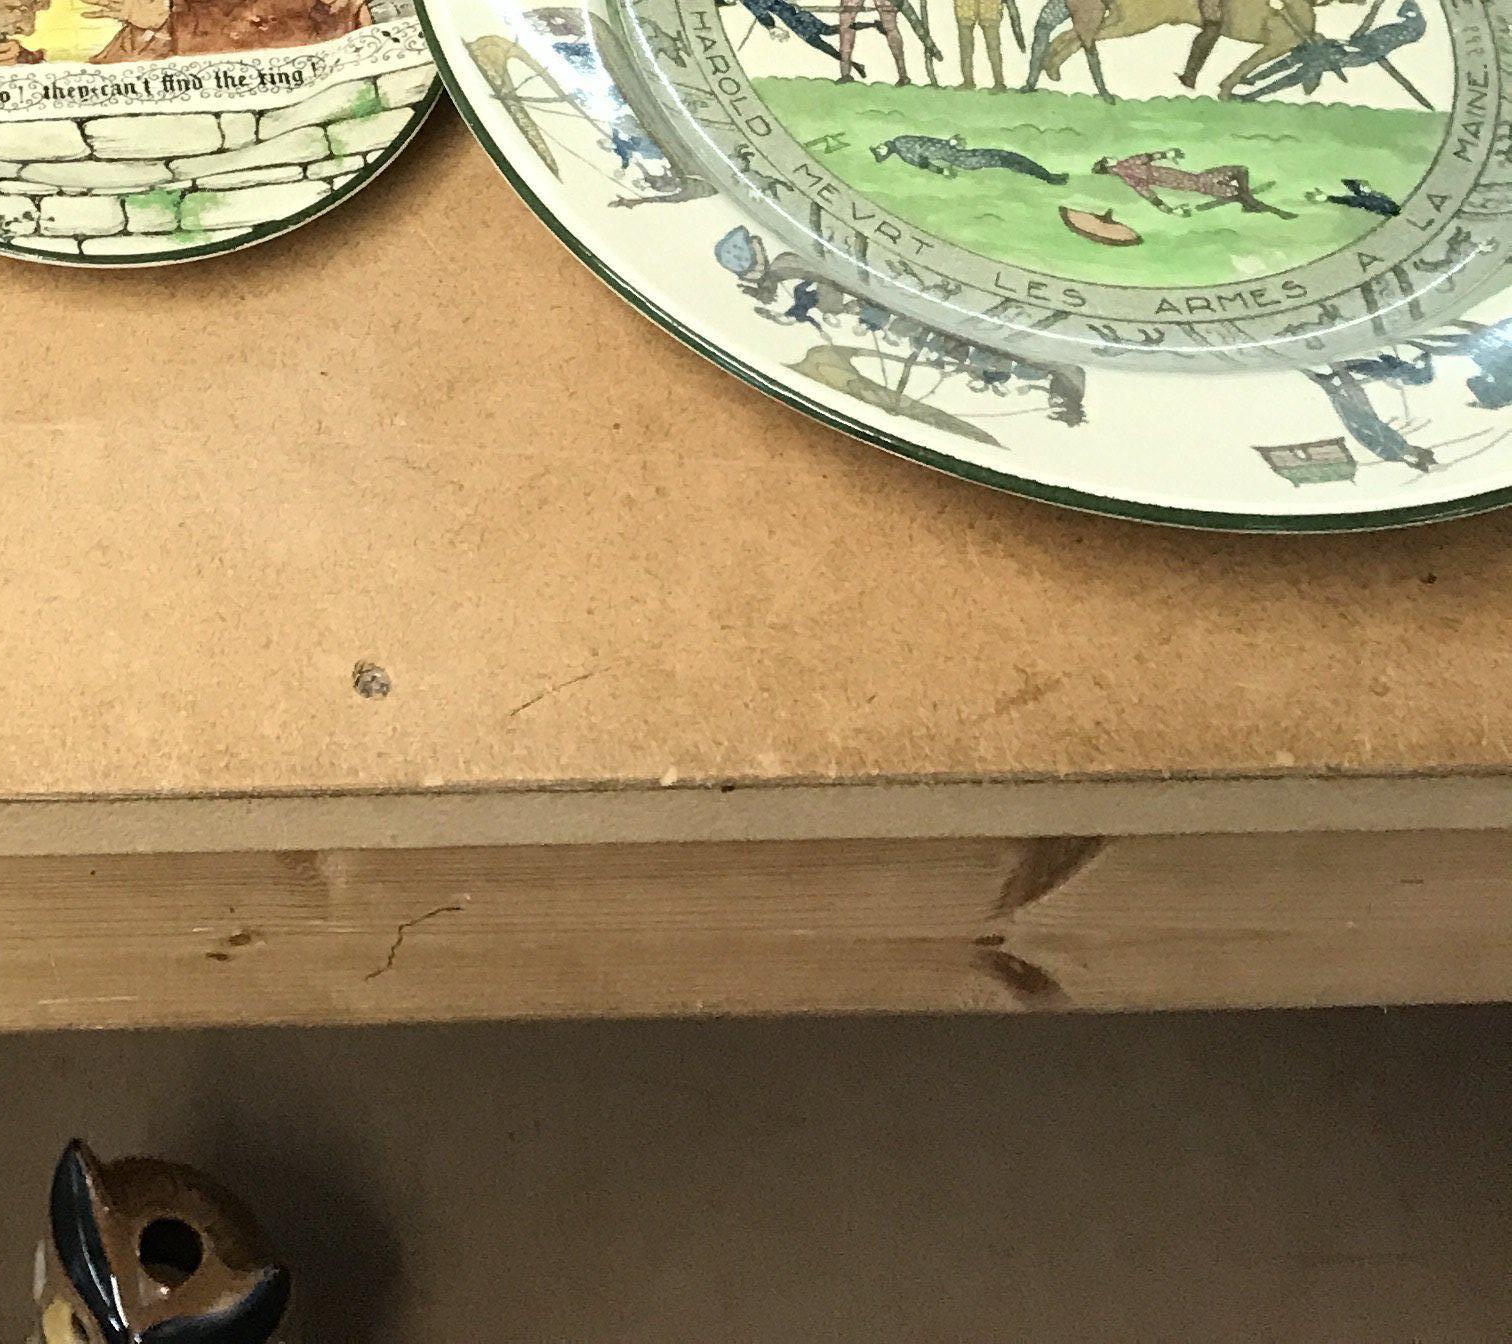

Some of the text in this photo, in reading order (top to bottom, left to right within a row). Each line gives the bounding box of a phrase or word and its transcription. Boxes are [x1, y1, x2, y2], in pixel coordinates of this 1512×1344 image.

[42, 76, 90, 106] they
[161, 71, 205, 95] find
[214, 69, 250, 90] the
[690, 11, 773, 137] HAROLD
[994, 270, 1088, 308] LES
[1154, 278, 1309, 316] ARMES
[1357, 251, 1386, 274] A
[1406, 192, 1453, 232] LA
